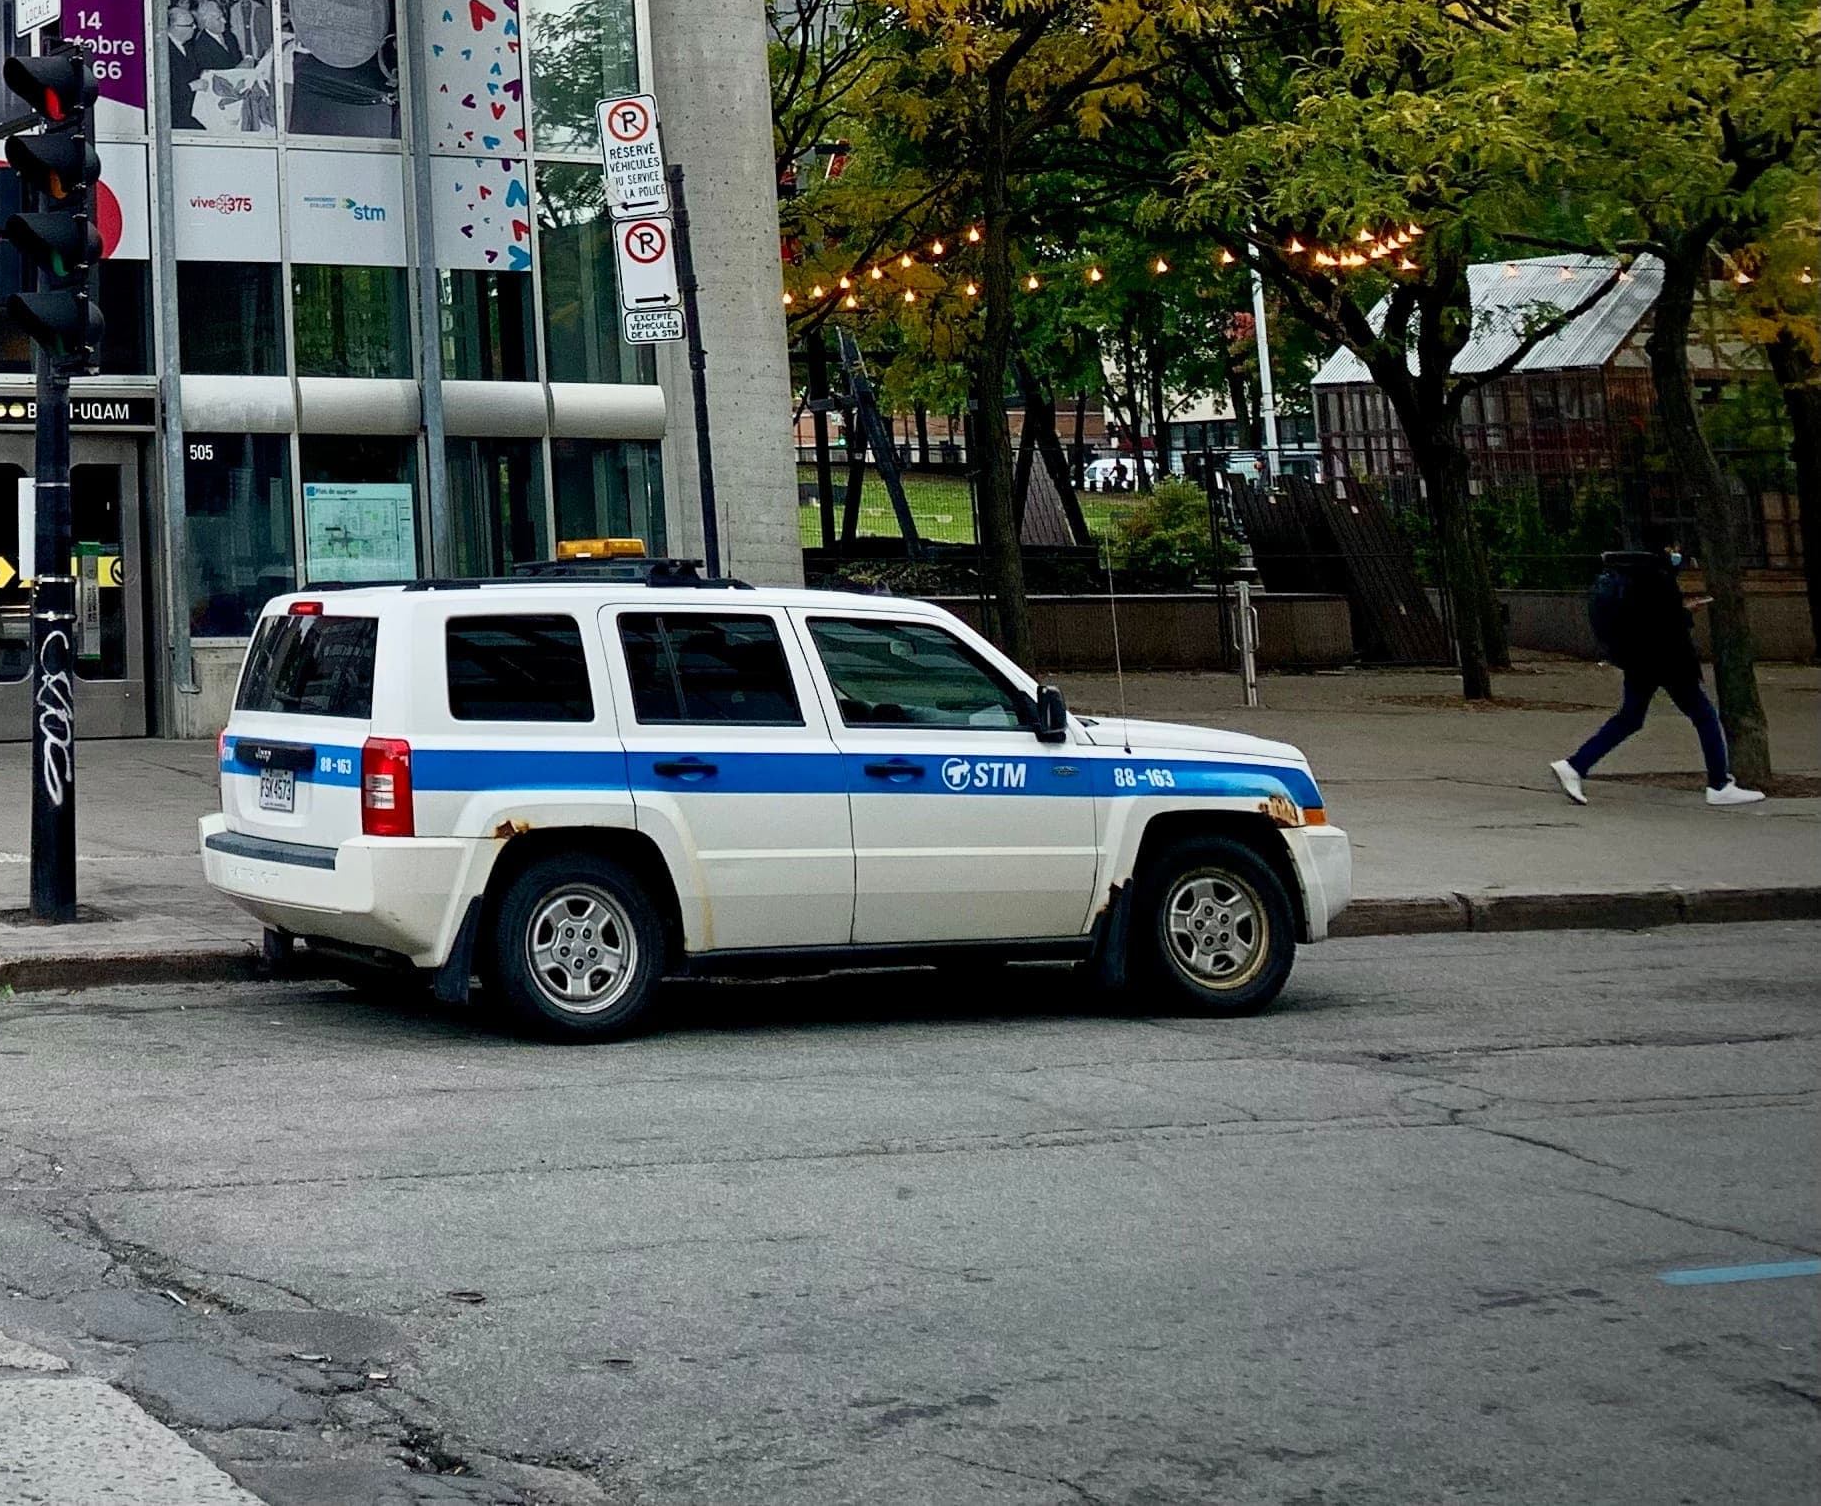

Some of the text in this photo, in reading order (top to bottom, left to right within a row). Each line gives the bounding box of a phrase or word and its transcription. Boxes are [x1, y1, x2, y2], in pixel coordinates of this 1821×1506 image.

[77, 10, 103, 30] 14
[92, 60, 123, 80] 66
[609, 157, 660, 173] VÉHICULES
[627, 171, 659, 185] SERVICE
[624, 189, 635, 200] LA
[638, 184, 666, 198] POLICE
[353, 204, 386, 222] stm
[661, 329, 679, 338] STM
[189, 444, 214, 461] 505
[320, 757, 353, 775] 88-163
[973, 762, 1027, 788] STM
[1114, 767, 1176, 788] 88-163
